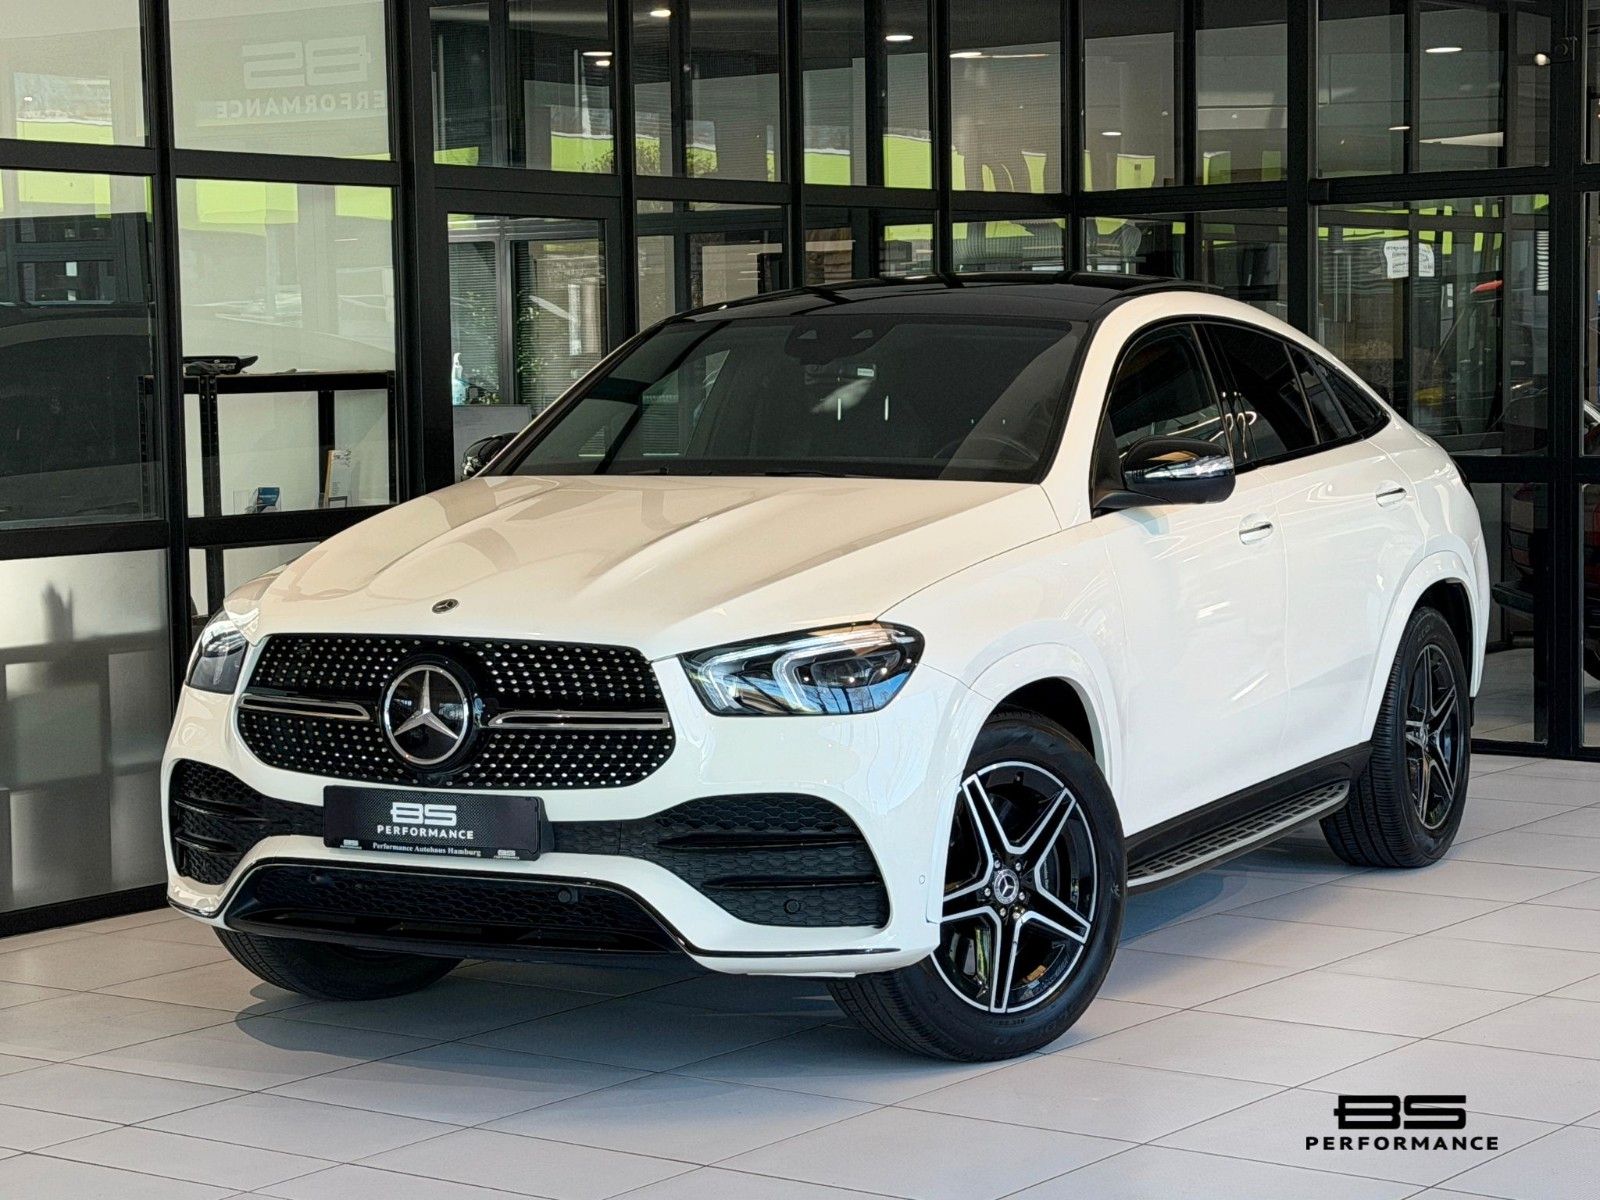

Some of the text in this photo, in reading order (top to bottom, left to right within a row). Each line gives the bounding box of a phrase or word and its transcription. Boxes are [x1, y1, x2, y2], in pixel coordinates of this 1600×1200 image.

[390, 801, 457, 827] BS
[376, 824, 474, 840] PERFORMANCE
[372, 841, 414, 852] Performance
[414, 845, 447, 854] Autohaus
[447, 847, 482, 857] Hamburg
